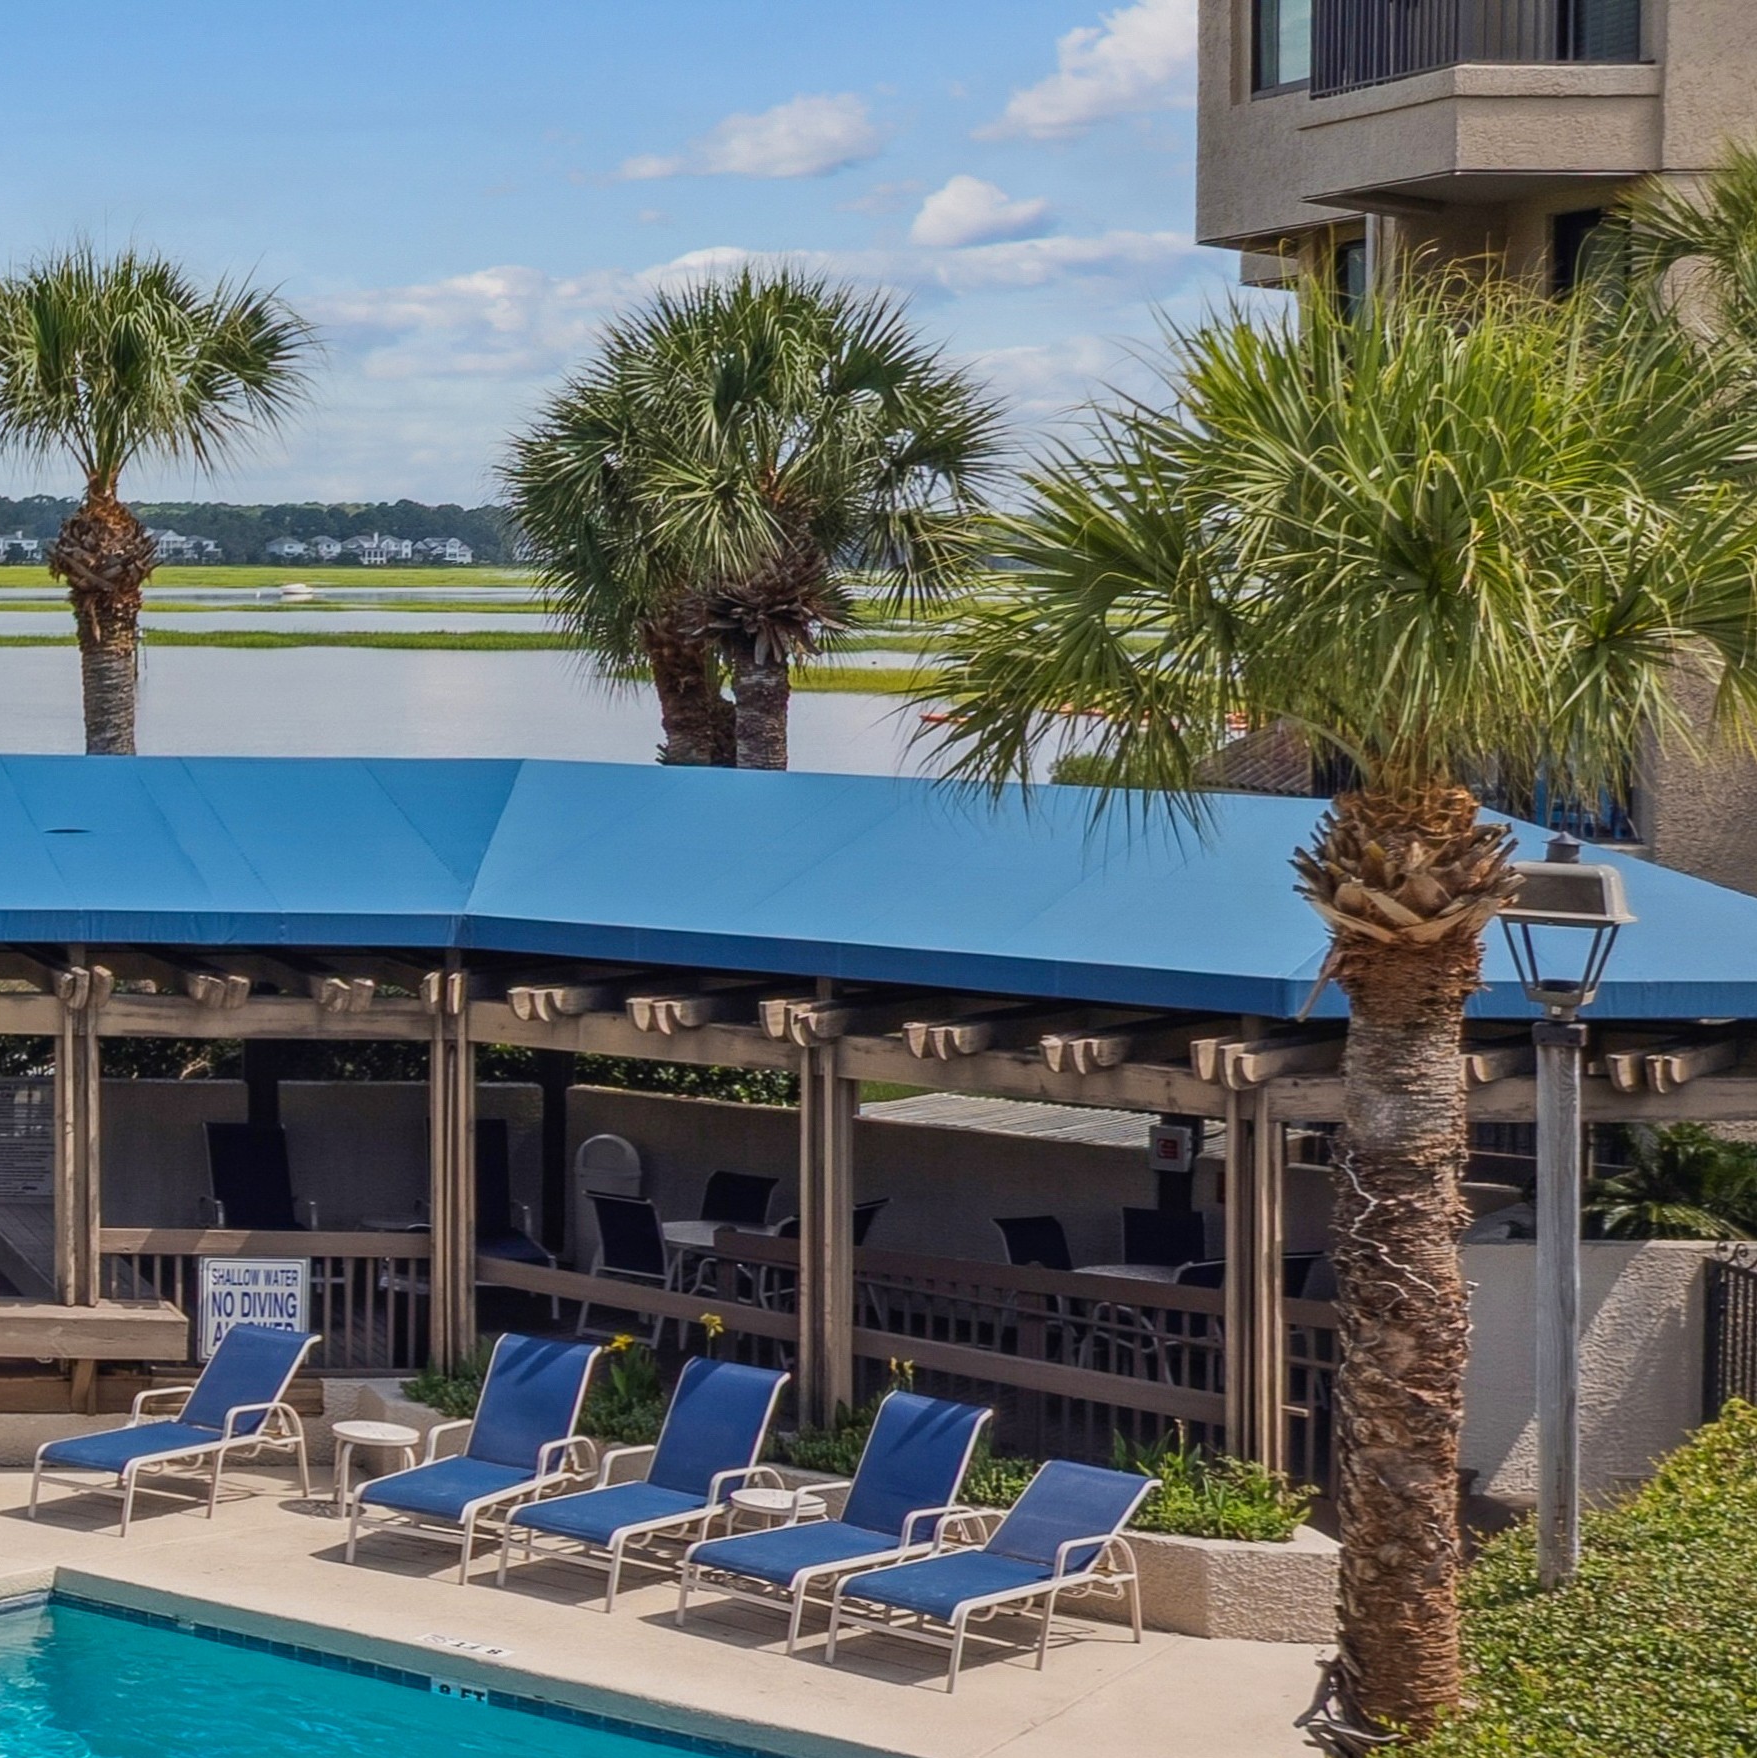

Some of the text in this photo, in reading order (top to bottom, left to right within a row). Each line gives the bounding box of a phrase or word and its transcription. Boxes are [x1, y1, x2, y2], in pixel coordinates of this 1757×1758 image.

[211, 1267, 298, 1287] SHALLOW WATER
[212, 1291, 297, 1319] NO DIVING
